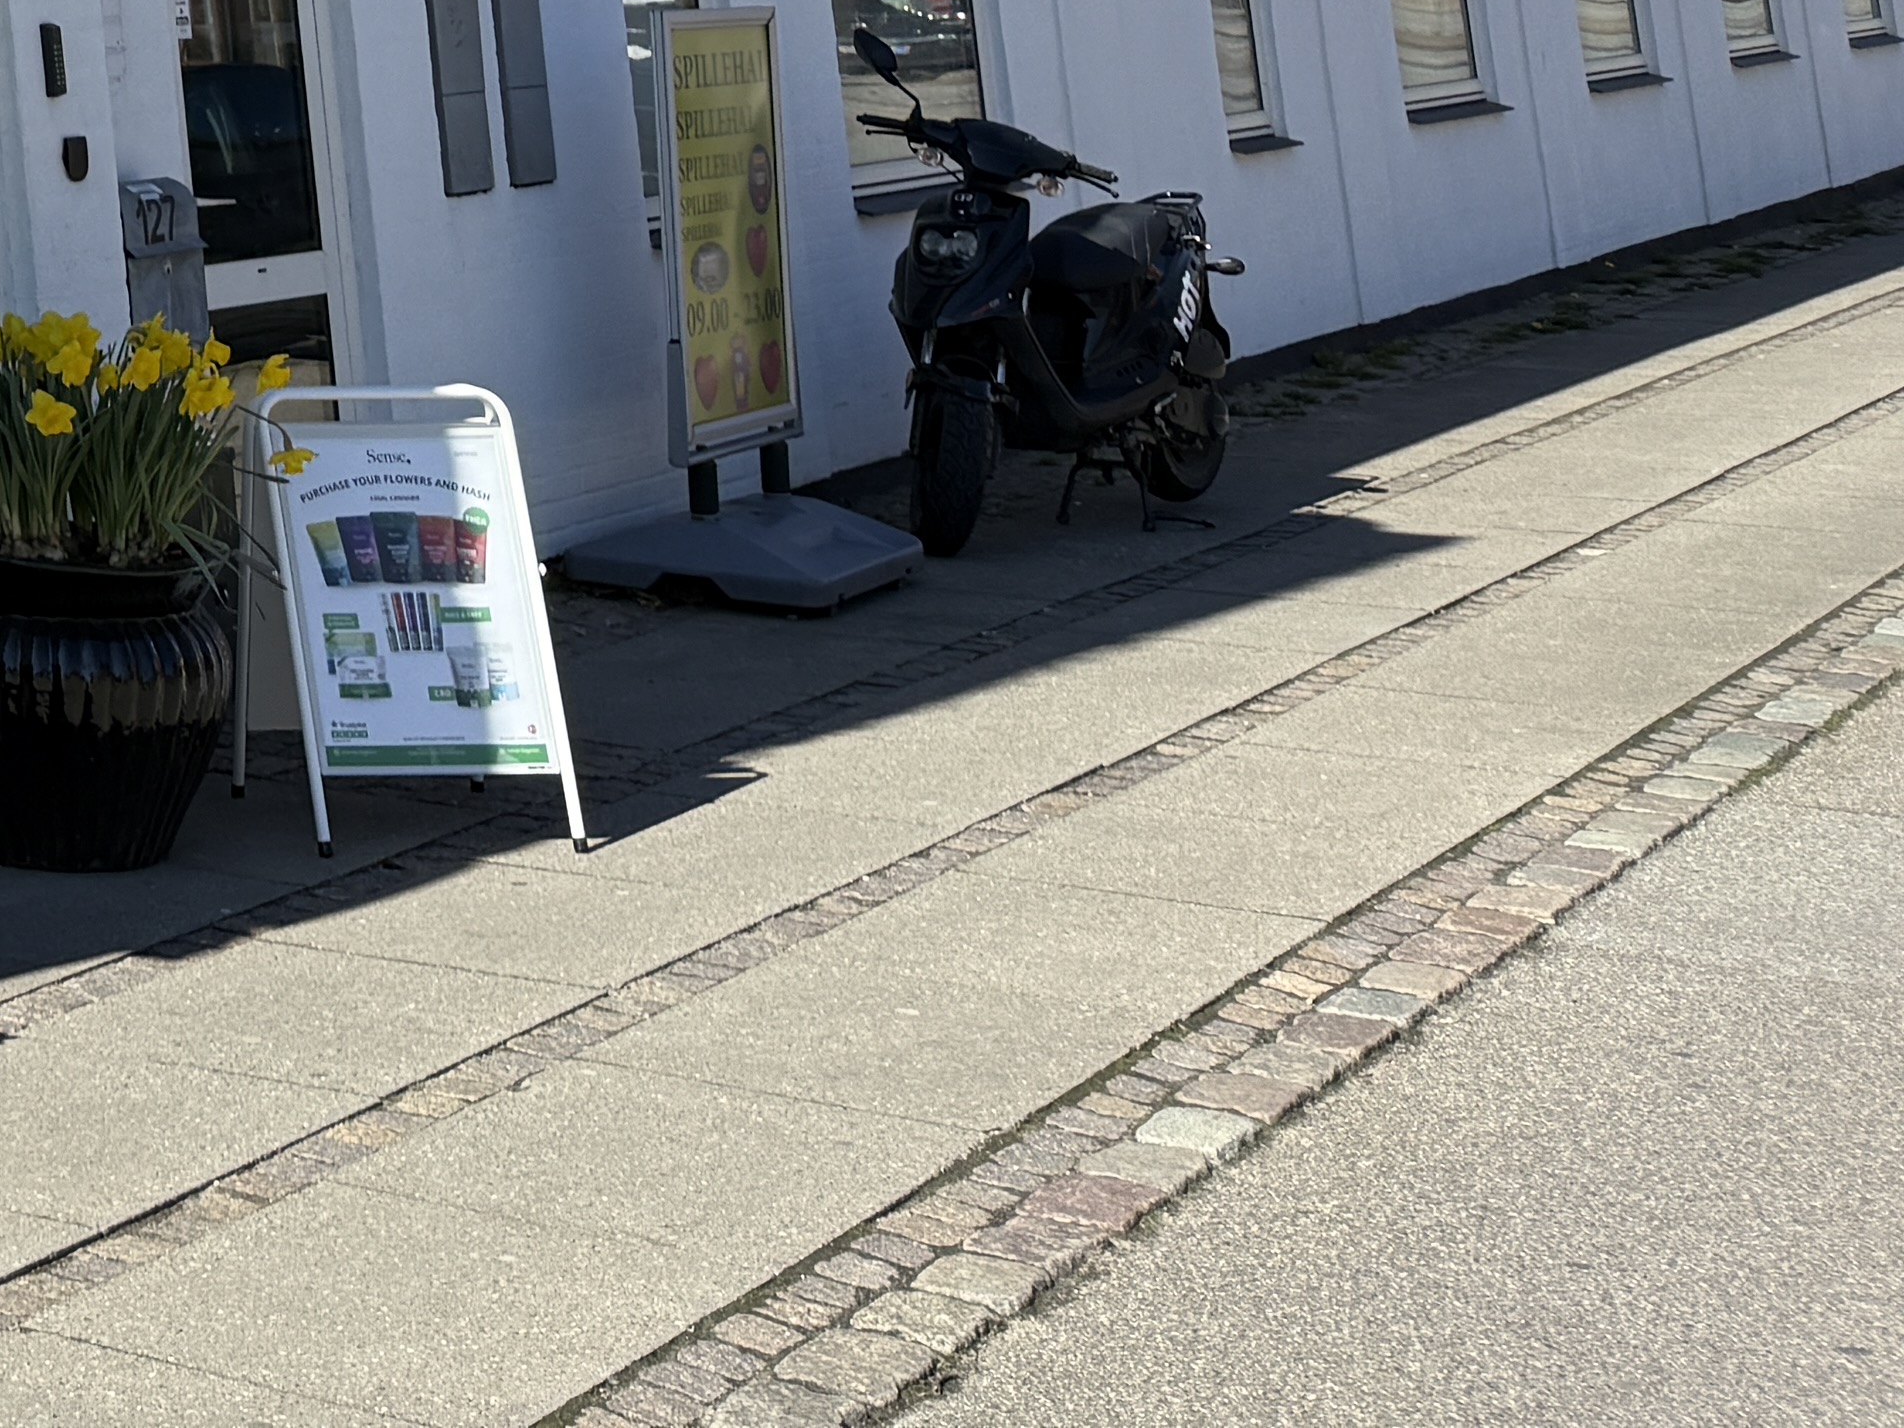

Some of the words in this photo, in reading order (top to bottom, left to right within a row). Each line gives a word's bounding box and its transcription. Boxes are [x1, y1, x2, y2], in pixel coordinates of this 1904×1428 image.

[136, 195, 176, 246] 127
[299, 477, 352, 504] PURCHASE
[352, 474, 382, 487] YOUR
[383, 473, 433, 487] FLOWERS
[434, 478, 459, 493] AND
